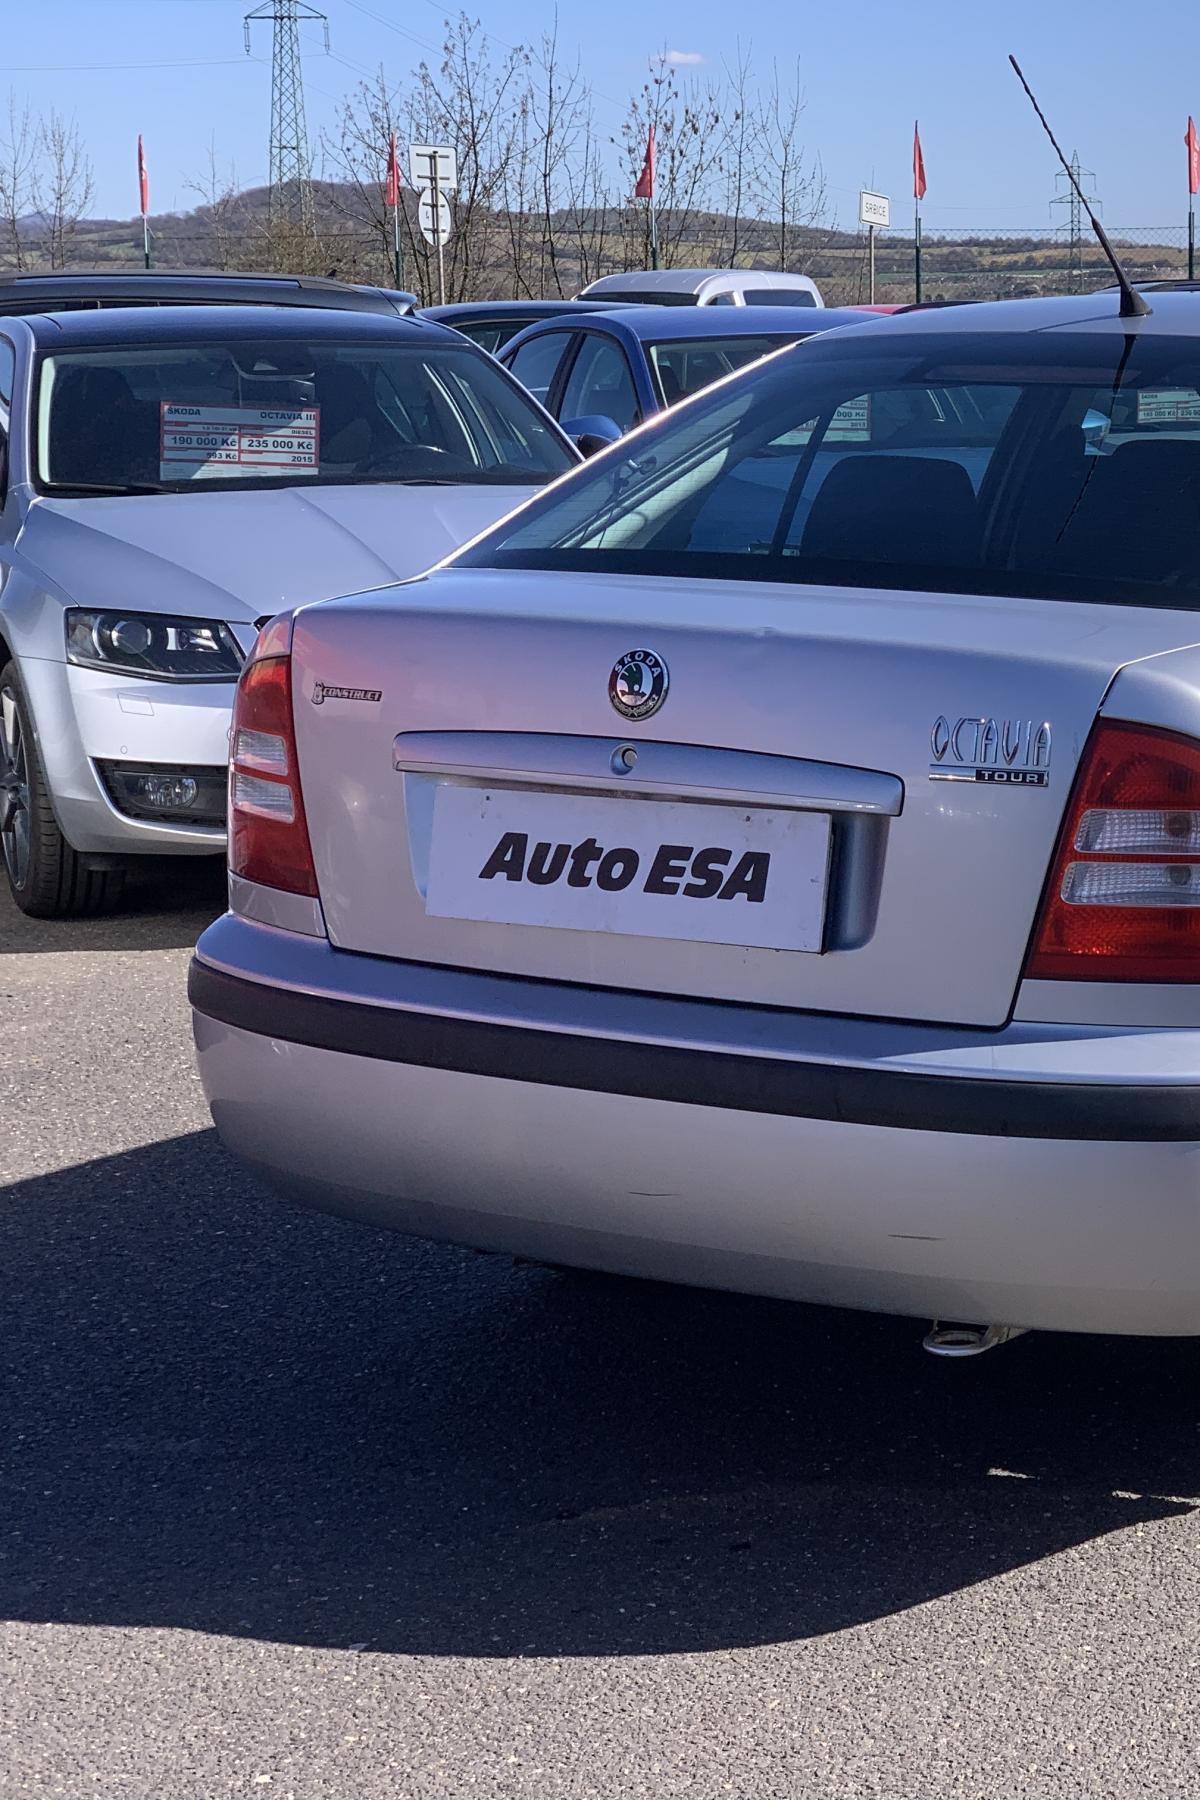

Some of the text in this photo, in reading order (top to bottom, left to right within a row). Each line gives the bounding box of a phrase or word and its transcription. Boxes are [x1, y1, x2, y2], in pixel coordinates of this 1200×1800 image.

[260, 412, 303, 421] OCTAVIA
[172, 436, 237, 447] 190 000 Kč
[247, 439, 313, 450] 235 000 Kč
[291, 455, 313, 463] 2015
[323, 687, 381, 701] CONSTRUCT
[930, 715, 1052, 767] OCTAVIA
[981, 770, 1039, 783] TOUR
[478, 832, 771, 903] Auto ESA
